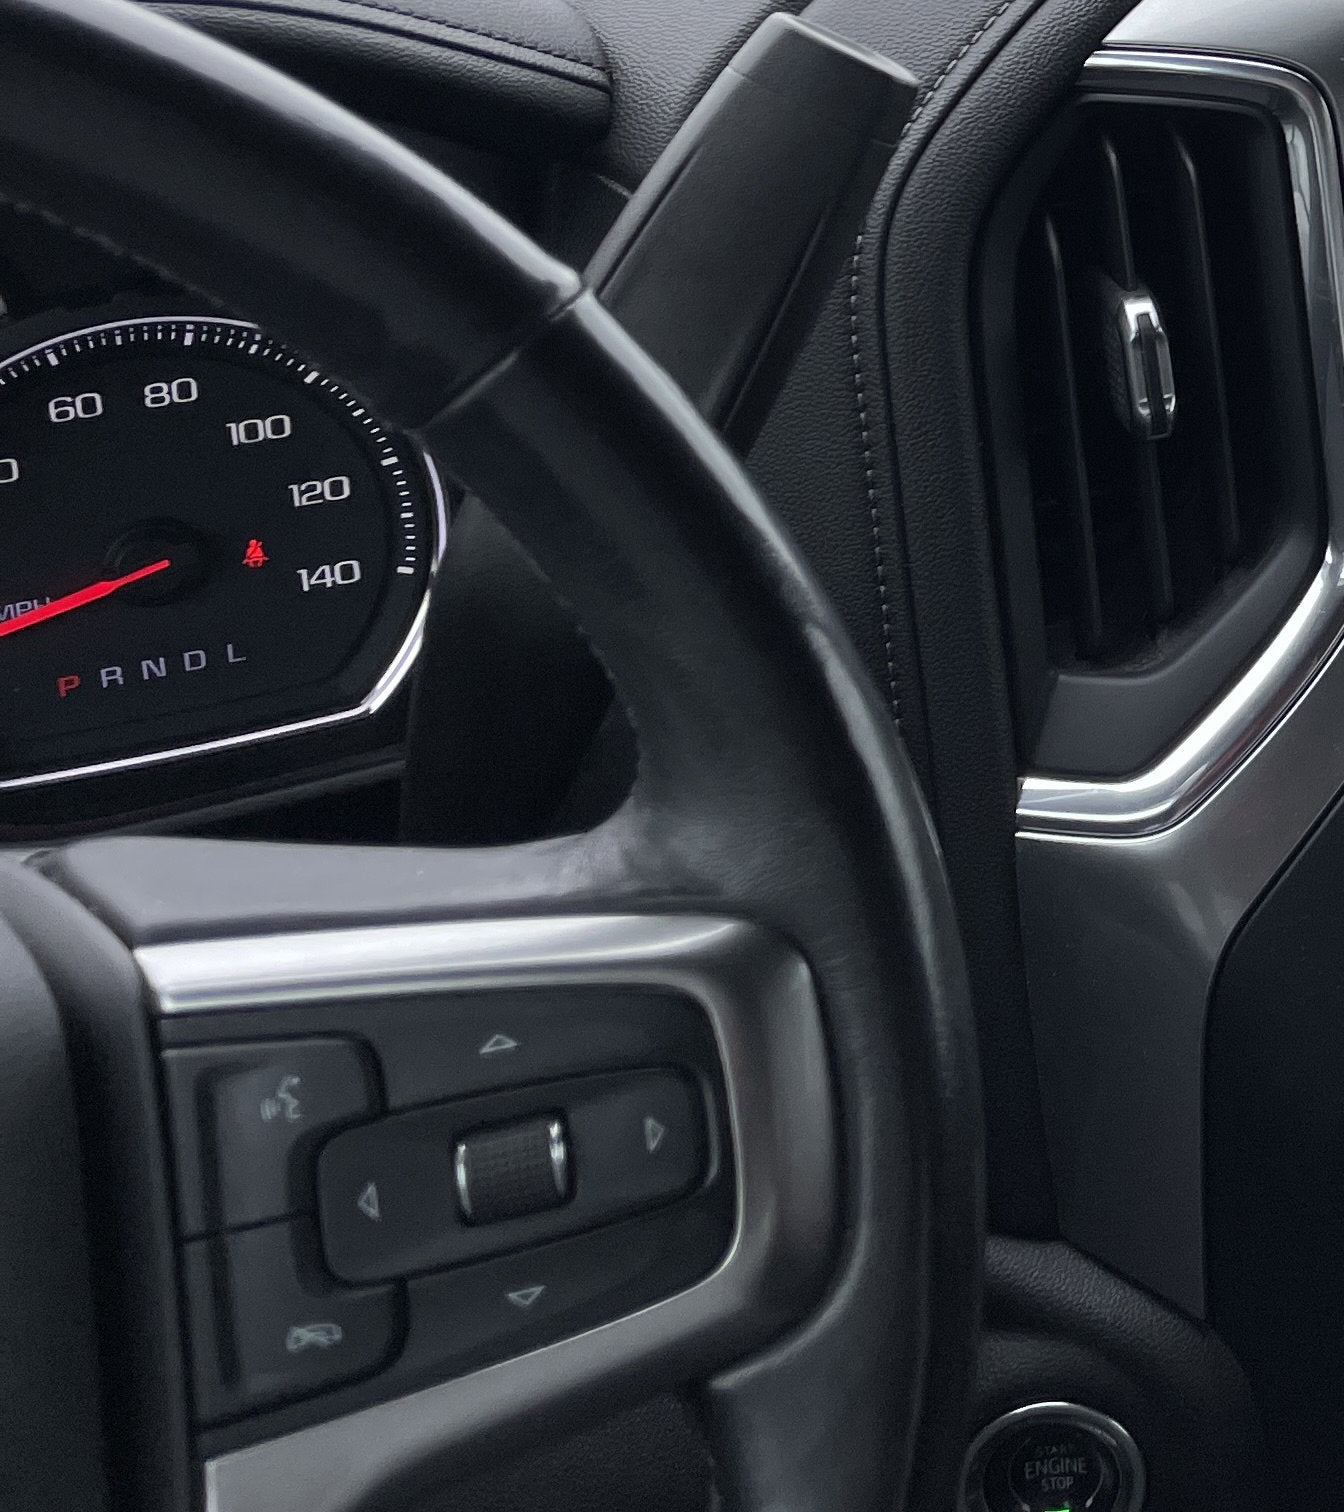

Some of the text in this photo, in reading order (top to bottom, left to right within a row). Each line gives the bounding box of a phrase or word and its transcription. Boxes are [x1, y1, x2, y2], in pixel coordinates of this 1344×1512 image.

[144, 378, 197, 407] 80
[49, 393, 102, 422] 60
[226, 415, 291, 445] 100
[0, 459, 18, 483] 0
[288, 476, 350, 507] 120
[297, 561, 360, 591] 140
[58, 644, 246, 696] P R N D L
[1024, 1457, 1088, 1481] ENGINE
[1041, 1475, 1074, 1492] STOP
